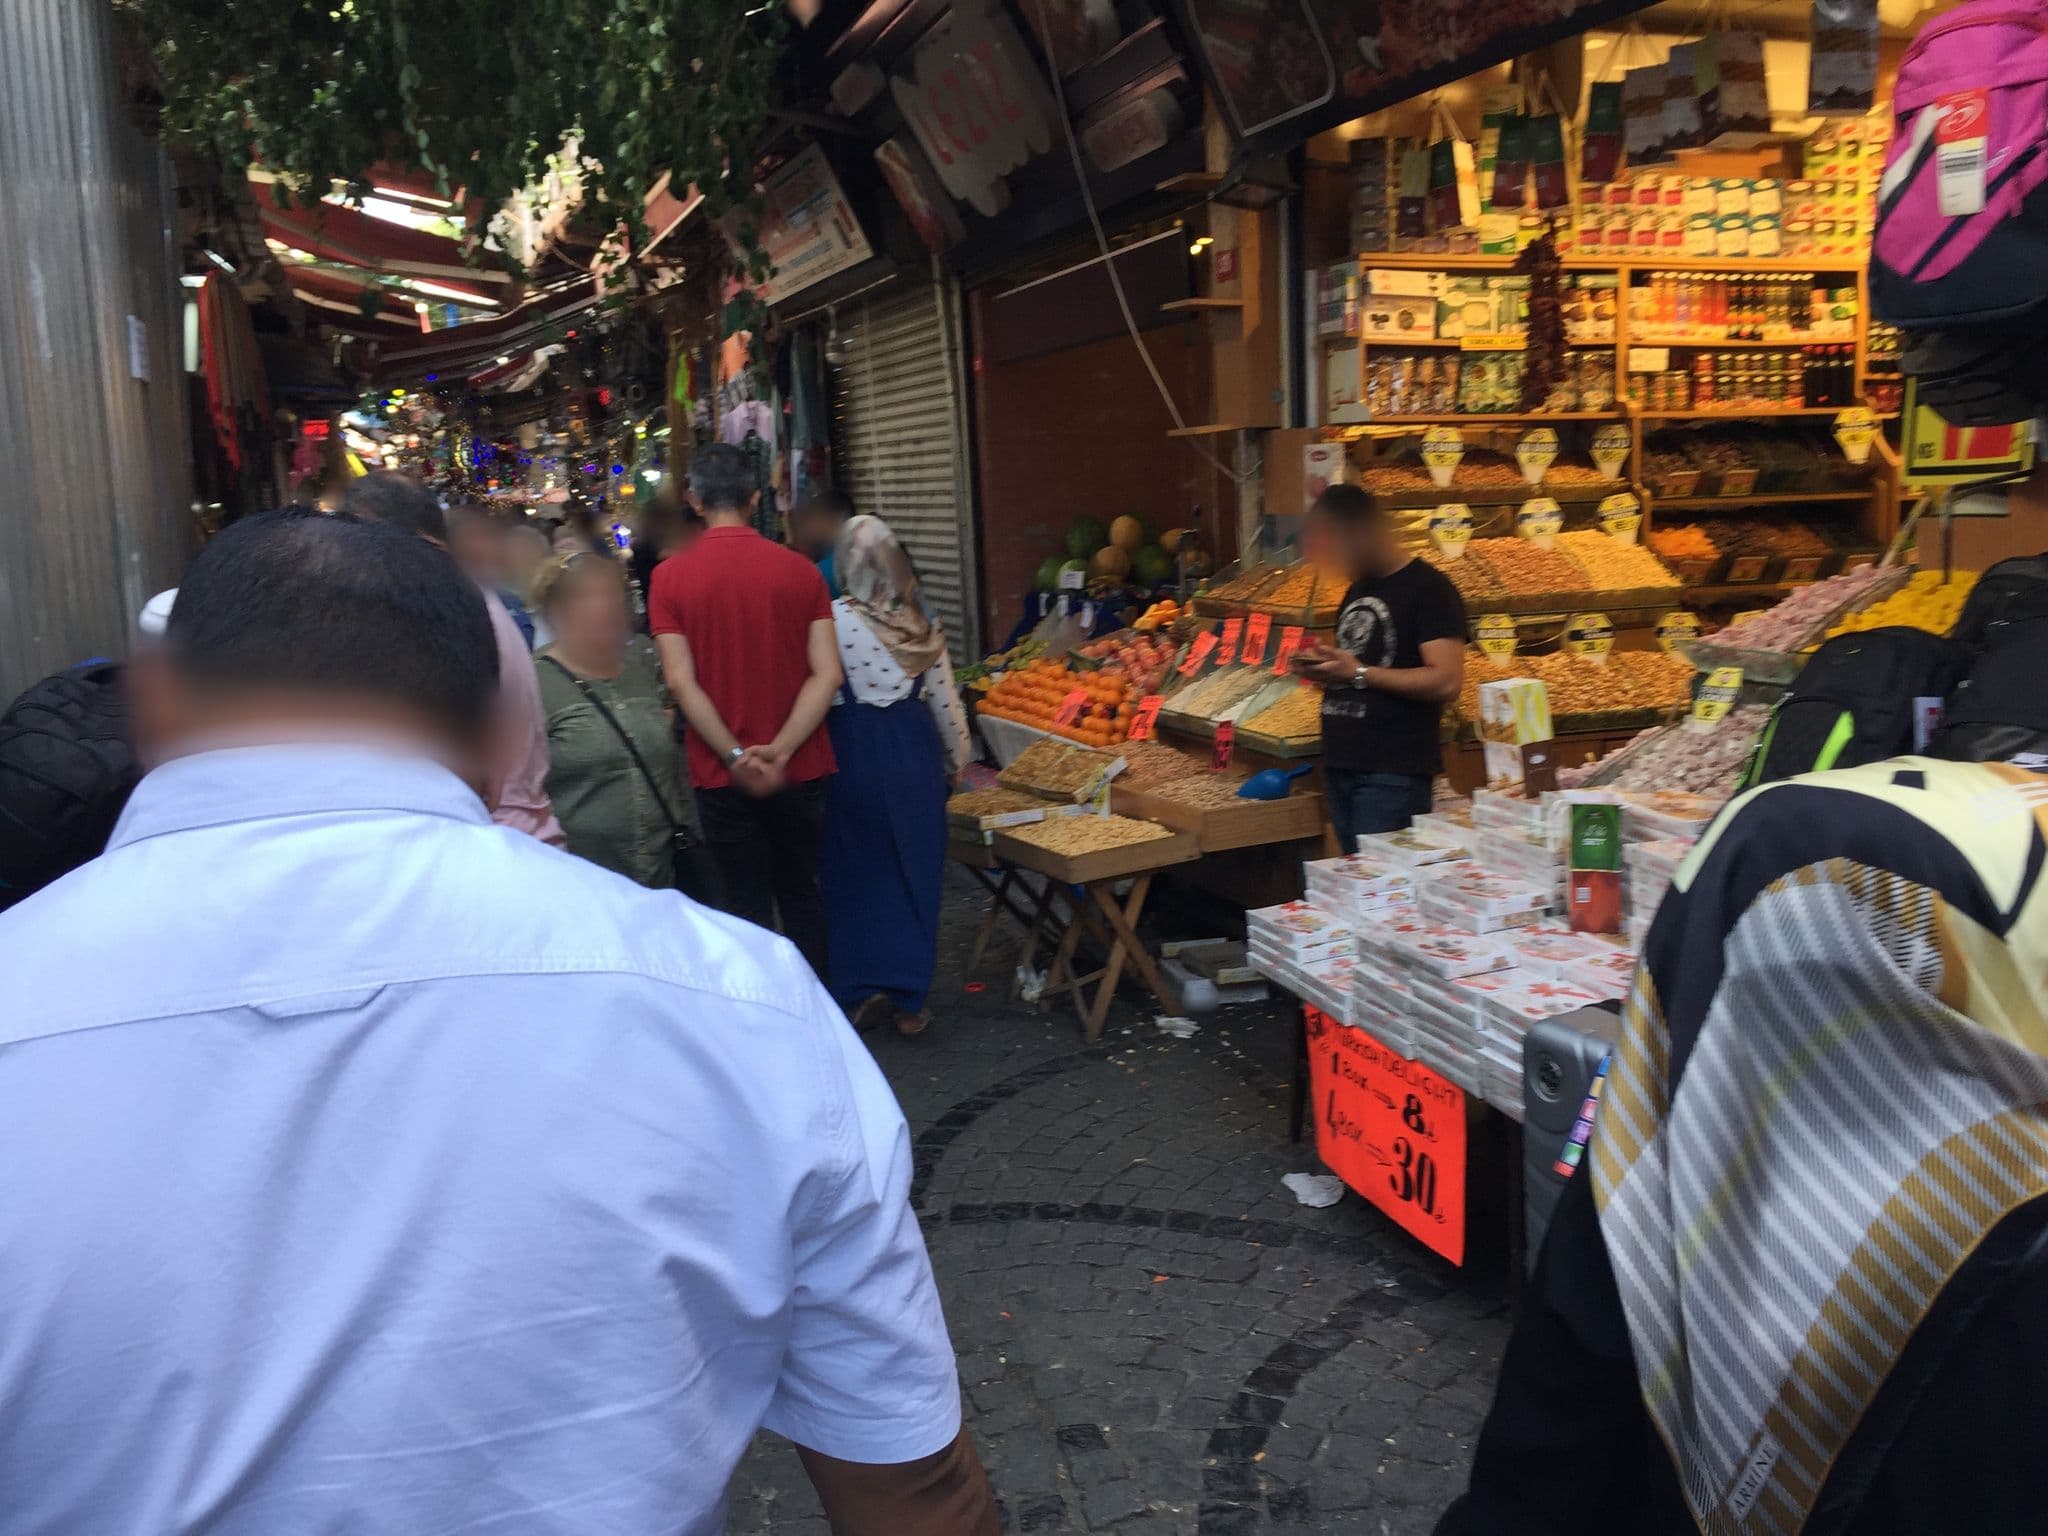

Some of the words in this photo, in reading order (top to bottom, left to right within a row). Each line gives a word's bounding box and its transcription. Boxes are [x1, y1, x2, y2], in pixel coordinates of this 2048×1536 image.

[1331, 1051, 1339, 1075] 1
[1403, 1093, 1424, 1135] 8
[1390, 1136, 1435, 1216] 30
